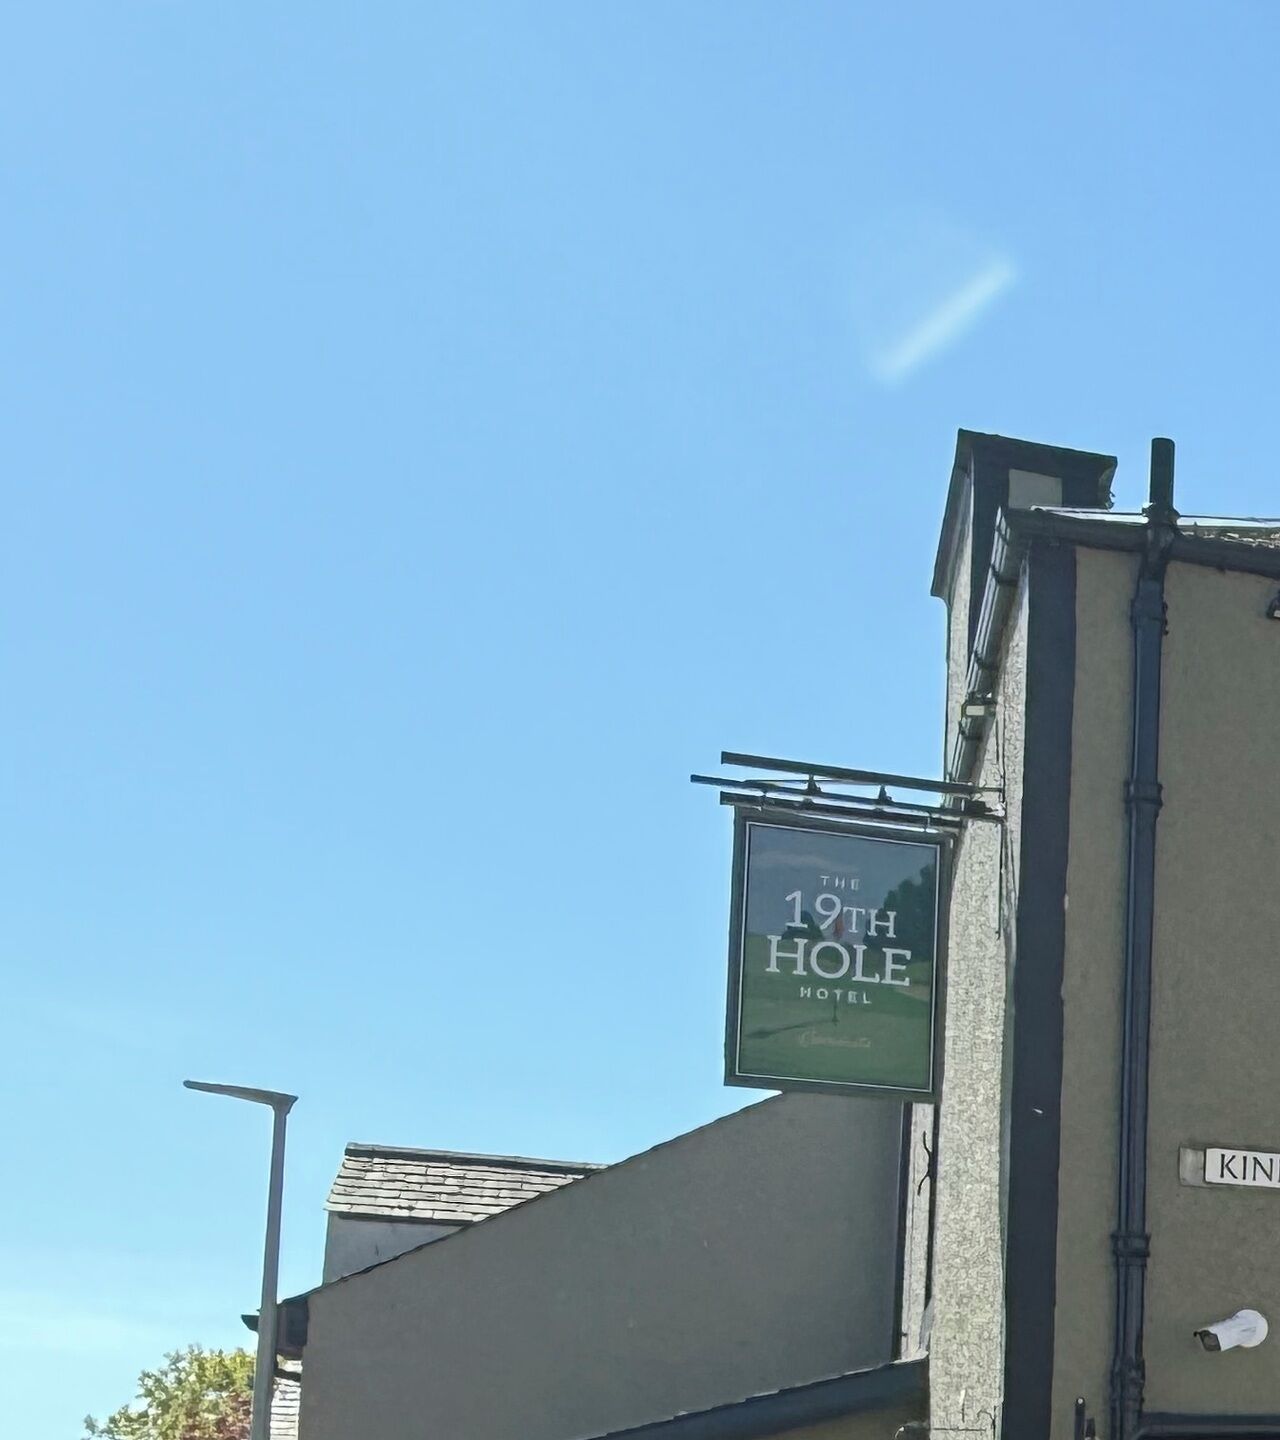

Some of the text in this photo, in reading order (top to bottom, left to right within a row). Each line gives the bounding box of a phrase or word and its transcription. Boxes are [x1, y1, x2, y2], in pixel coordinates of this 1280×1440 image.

[819, 875, 861, 891] THE
[784, 889, 898, 939] 19TH
[764, 934, 913, 987] HOLE
[799, 986, 874, 1005] HOTEL
